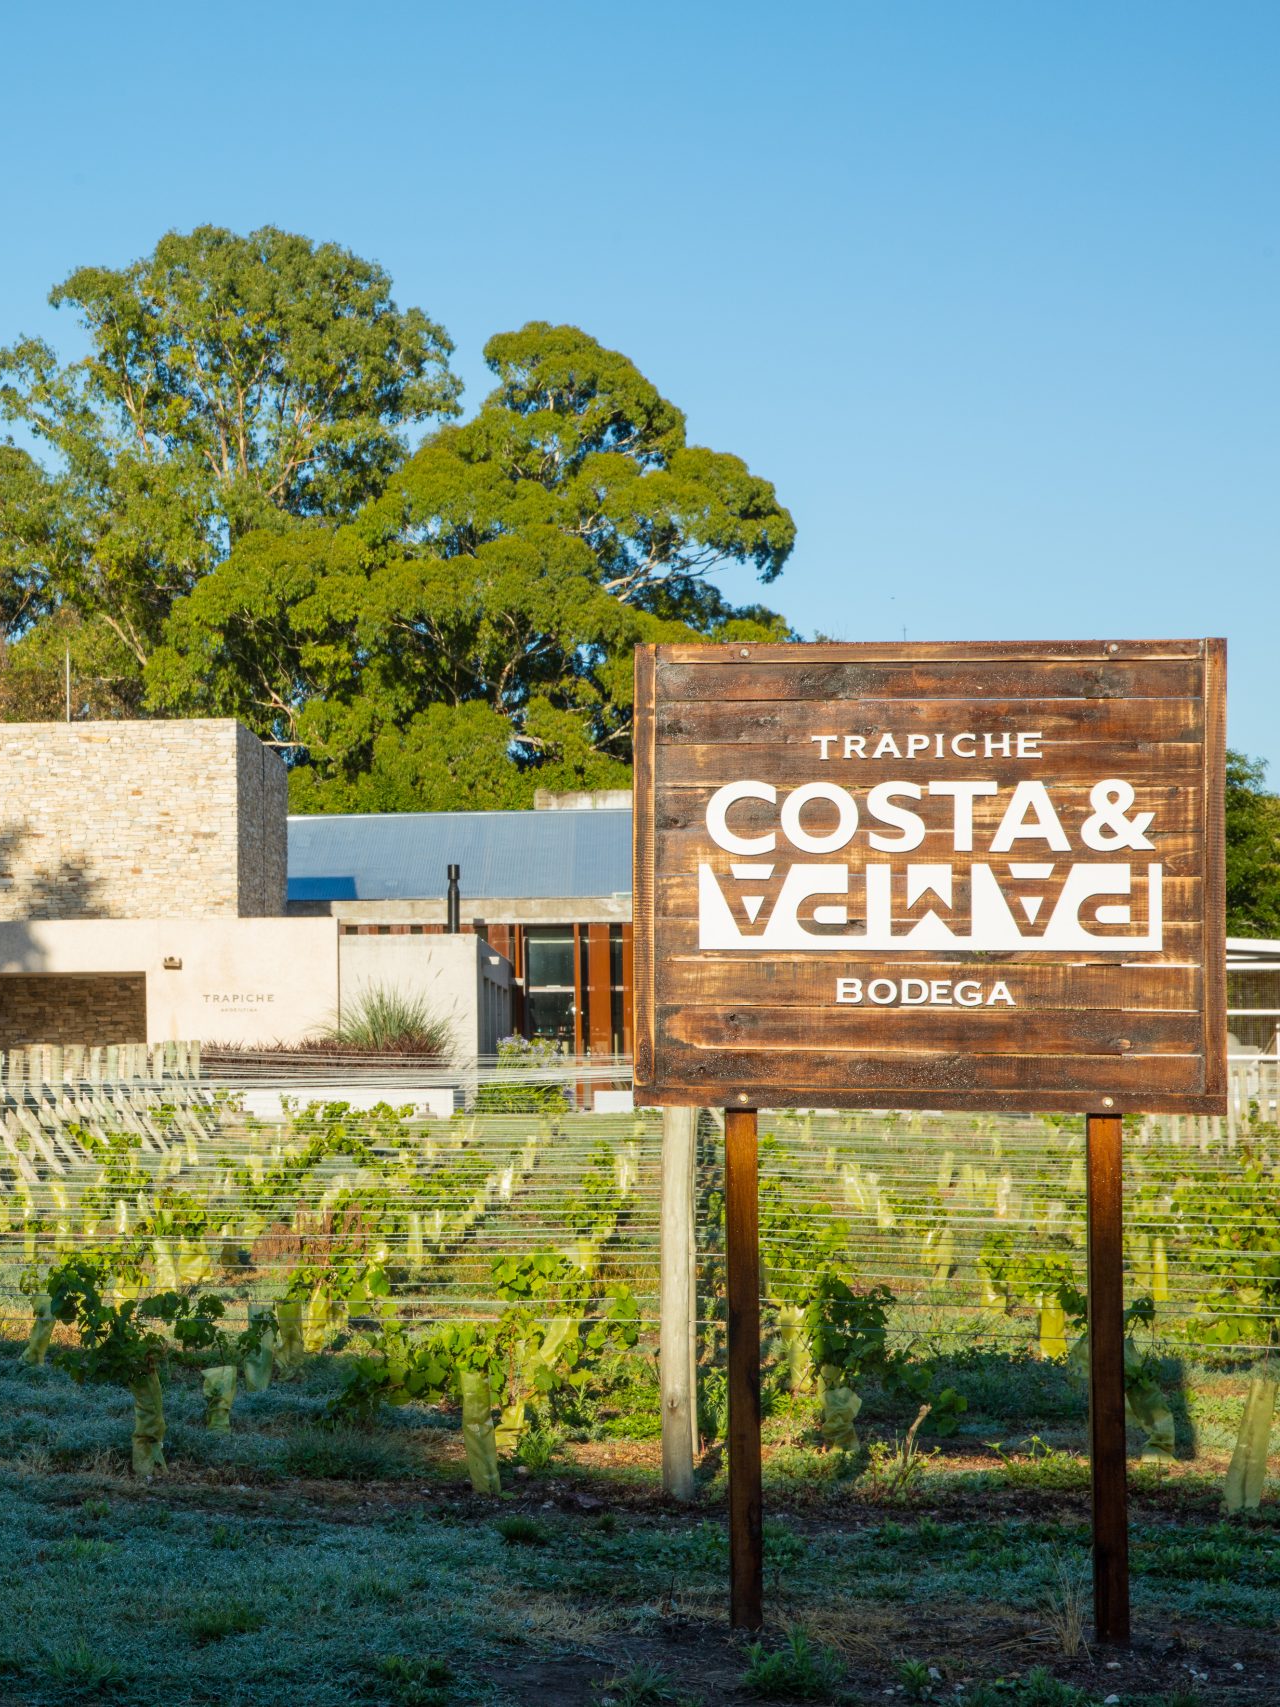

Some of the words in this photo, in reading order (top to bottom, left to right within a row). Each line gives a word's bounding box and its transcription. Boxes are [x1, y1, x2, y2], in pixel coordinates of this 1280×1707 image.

[811, 731, 1044, 761] TRAPICHE
[705, 778, 1156, 856] COSTA&
[701, 863, 1156, 941] PAMPA
[202, 994, 274, 1002] TRAPICHE
[836, 977, 1017, 1007] BODEGA
